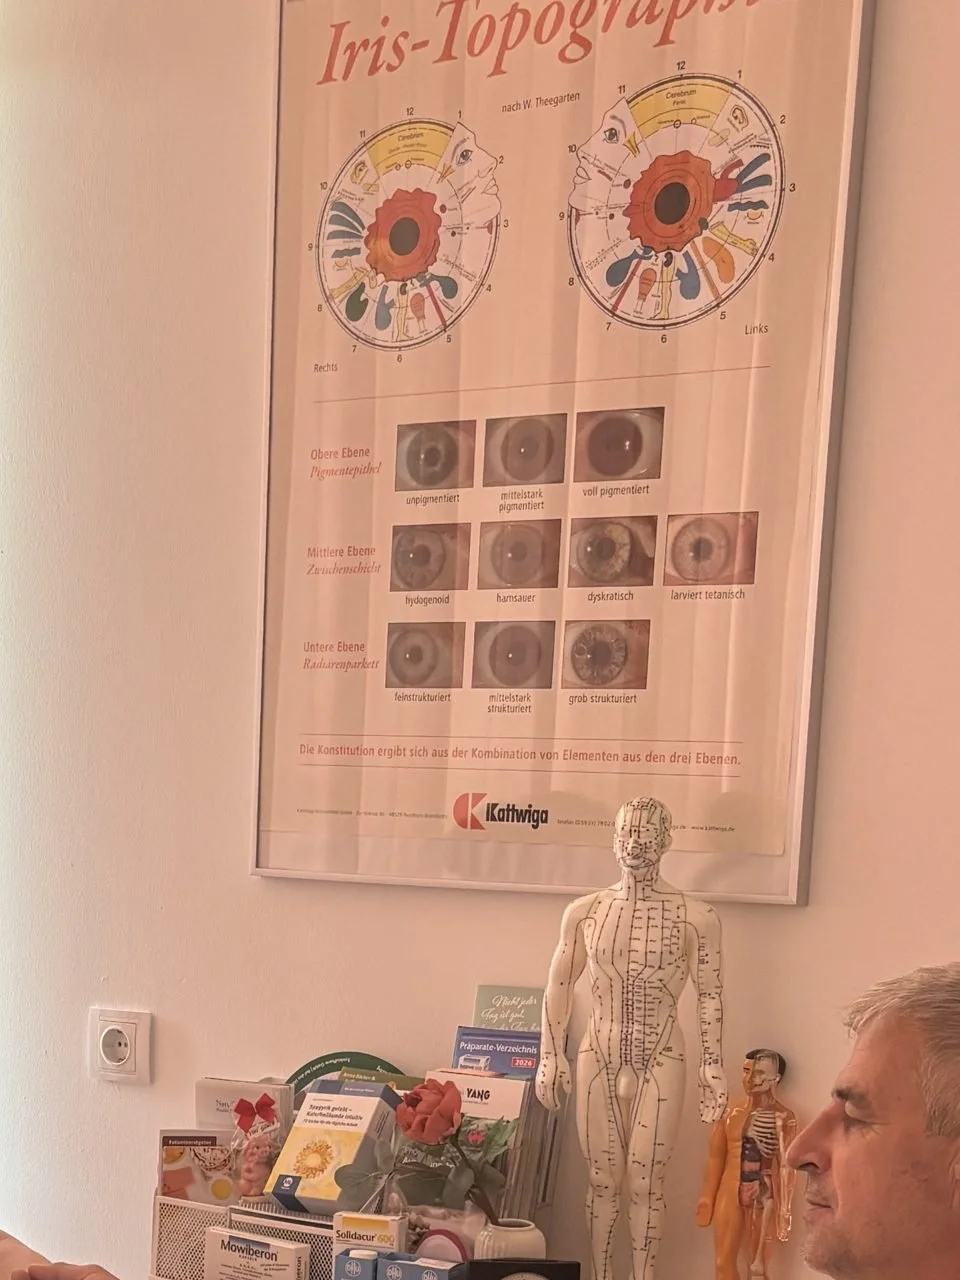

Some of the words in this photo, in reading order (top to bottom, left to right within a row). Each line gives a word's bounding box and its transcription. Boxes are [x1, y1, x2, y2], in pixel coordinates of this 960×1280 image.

[677, 61, 686, 70] 12
[618, 85, 626, 94] 11
[501, 101, 521, 112] nach
[535, 92, 580, 108] Theegarten
[406, 107, 415, 116] 12
[568, 144, 577, 153] 10
[320, 182, 328, 190] 10
[745, 324, 769, 335] Links
[313, 363, 338, 373] Rechts
[310, 448, 339, 460] Obere
[341, 447, 370, 459] Ebene
[500, 488, 544, 500] mittelstark
[582, 487, 598, 497] voll
[600, 484, 650, 499] pigmentiert
[406, 493, 461, 506] unpigmentiert
[498, 501, 545, 513] pigmentiert
[346, 545, 376, 557] Ebene
[587, 590, 634, 602] dyskratisch
[670, 589, 702, 600] larviert
[705, 589, 745, 600] tetanisch
[303, 642, 335, 653] Untere
[336, 641, 365, 652] Ebene
[394, 692, 451, 702] feinstrukturiert
[489, 693, 532, 703] mittelstark
[568, 694, 588, 705] grob
[590, 694, 637, 704] strukturiert
[487, 704, 531, 714] strukturiert
[299, 744, 315, 755] Die
[317, 744, 375, 757] Konstitution
[377, 747, 406, 759] ergibt
[409, 746, 429, 757] sich
[431, 749, 449, 758] aus
[452, 747, 468, 759] der
[471, 748, 536, 760] Kombination
[539, 752, 559, 761] von
[562, 750, 619, 762] Elementen
[622, 752, 641, 762] aus
[645, 751, 666, 763] den
[669, 751, 691, 765] drei
[695, 752, 741, 765] Ebenen.
[485, 802, 549, 829] Kattwiga
[459, 1041, 538, 1055] Präparate-Verzeichnis
[466, 1087, 491, 1101] YANG
[335, 1230, 375, 1242] Solidacur
[220, 1239, 278, 1262] Mowiberon
